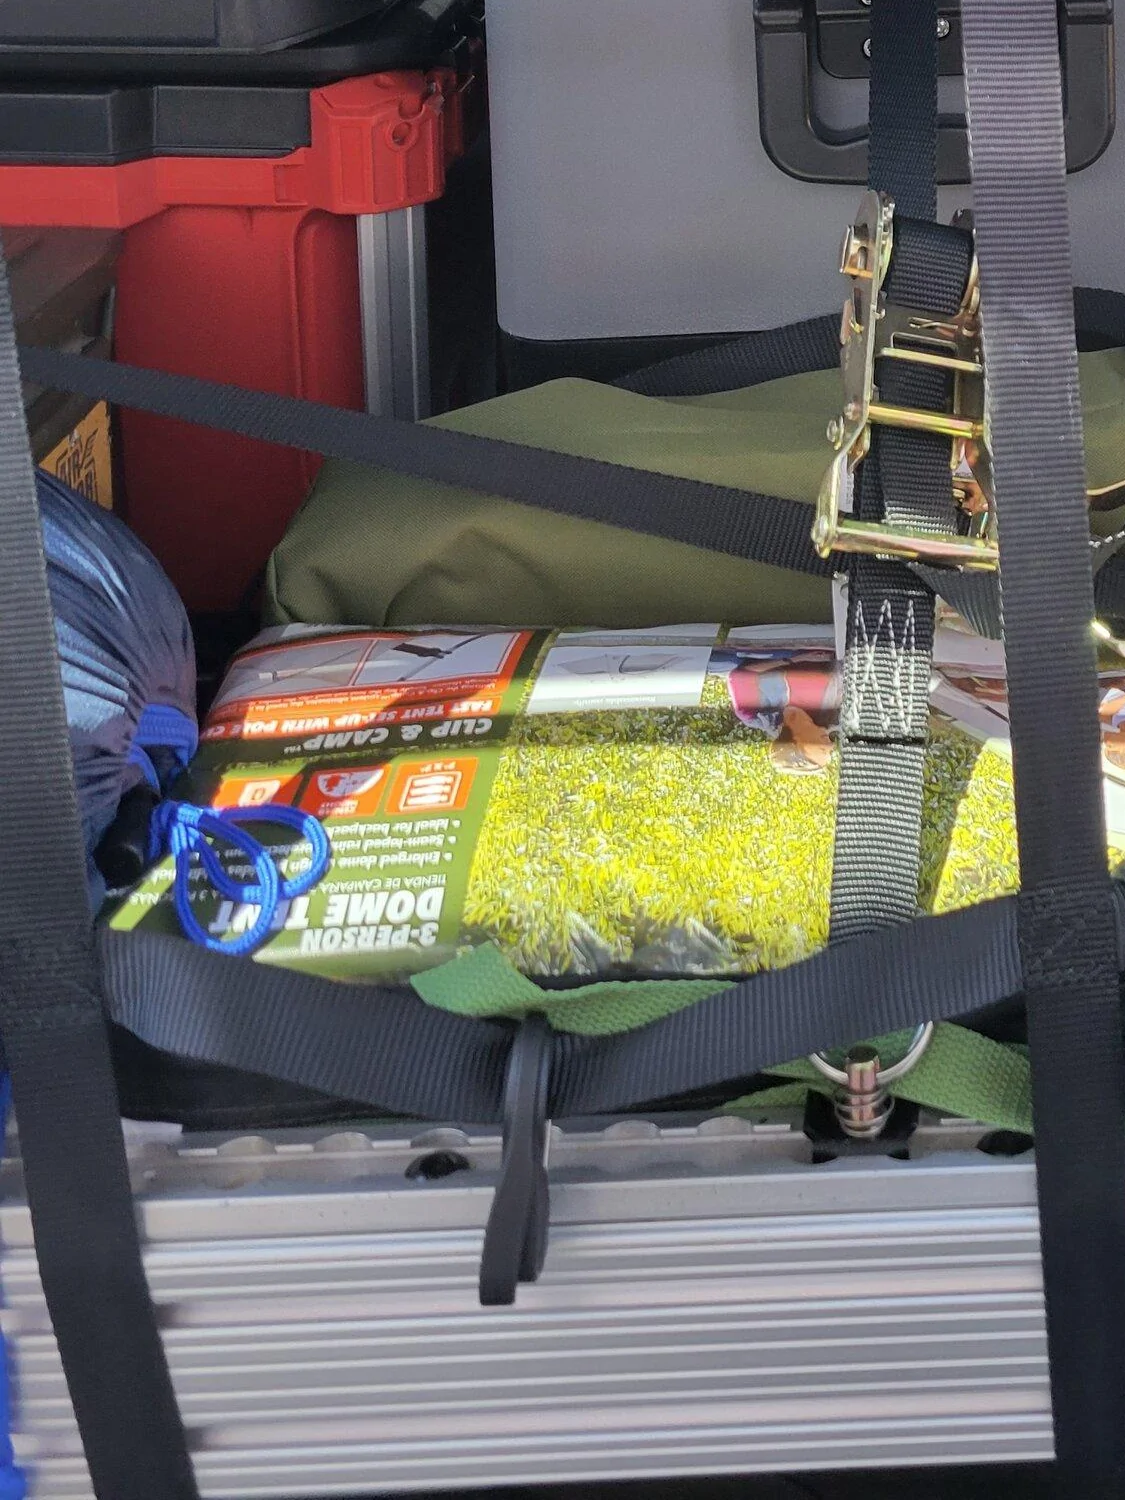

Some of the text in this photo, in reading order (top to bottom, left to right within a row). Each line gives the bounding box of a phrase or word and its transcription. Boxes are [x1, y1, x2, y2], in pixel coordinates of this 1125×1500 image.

[400, 704, 444, 719] TENT
[448, 699, 493, 713] FAST
[230, 721, 279, 736] POLE
[281, 717, 331, 734] WITH
[400, 724, 423, 741] &
[431, 717, 493, 739] CLIP
[390, 821, 413, 836] for
[339, 854, 378, 871] dome
[379, 851, 441, 871] Enlarged
[385, 877, 401, 888] DE
[403, 873, 446, 888] TIENDA
[323, 886, 446, 927] DOME
[300, 921, 440, 956] 3-PERSON
